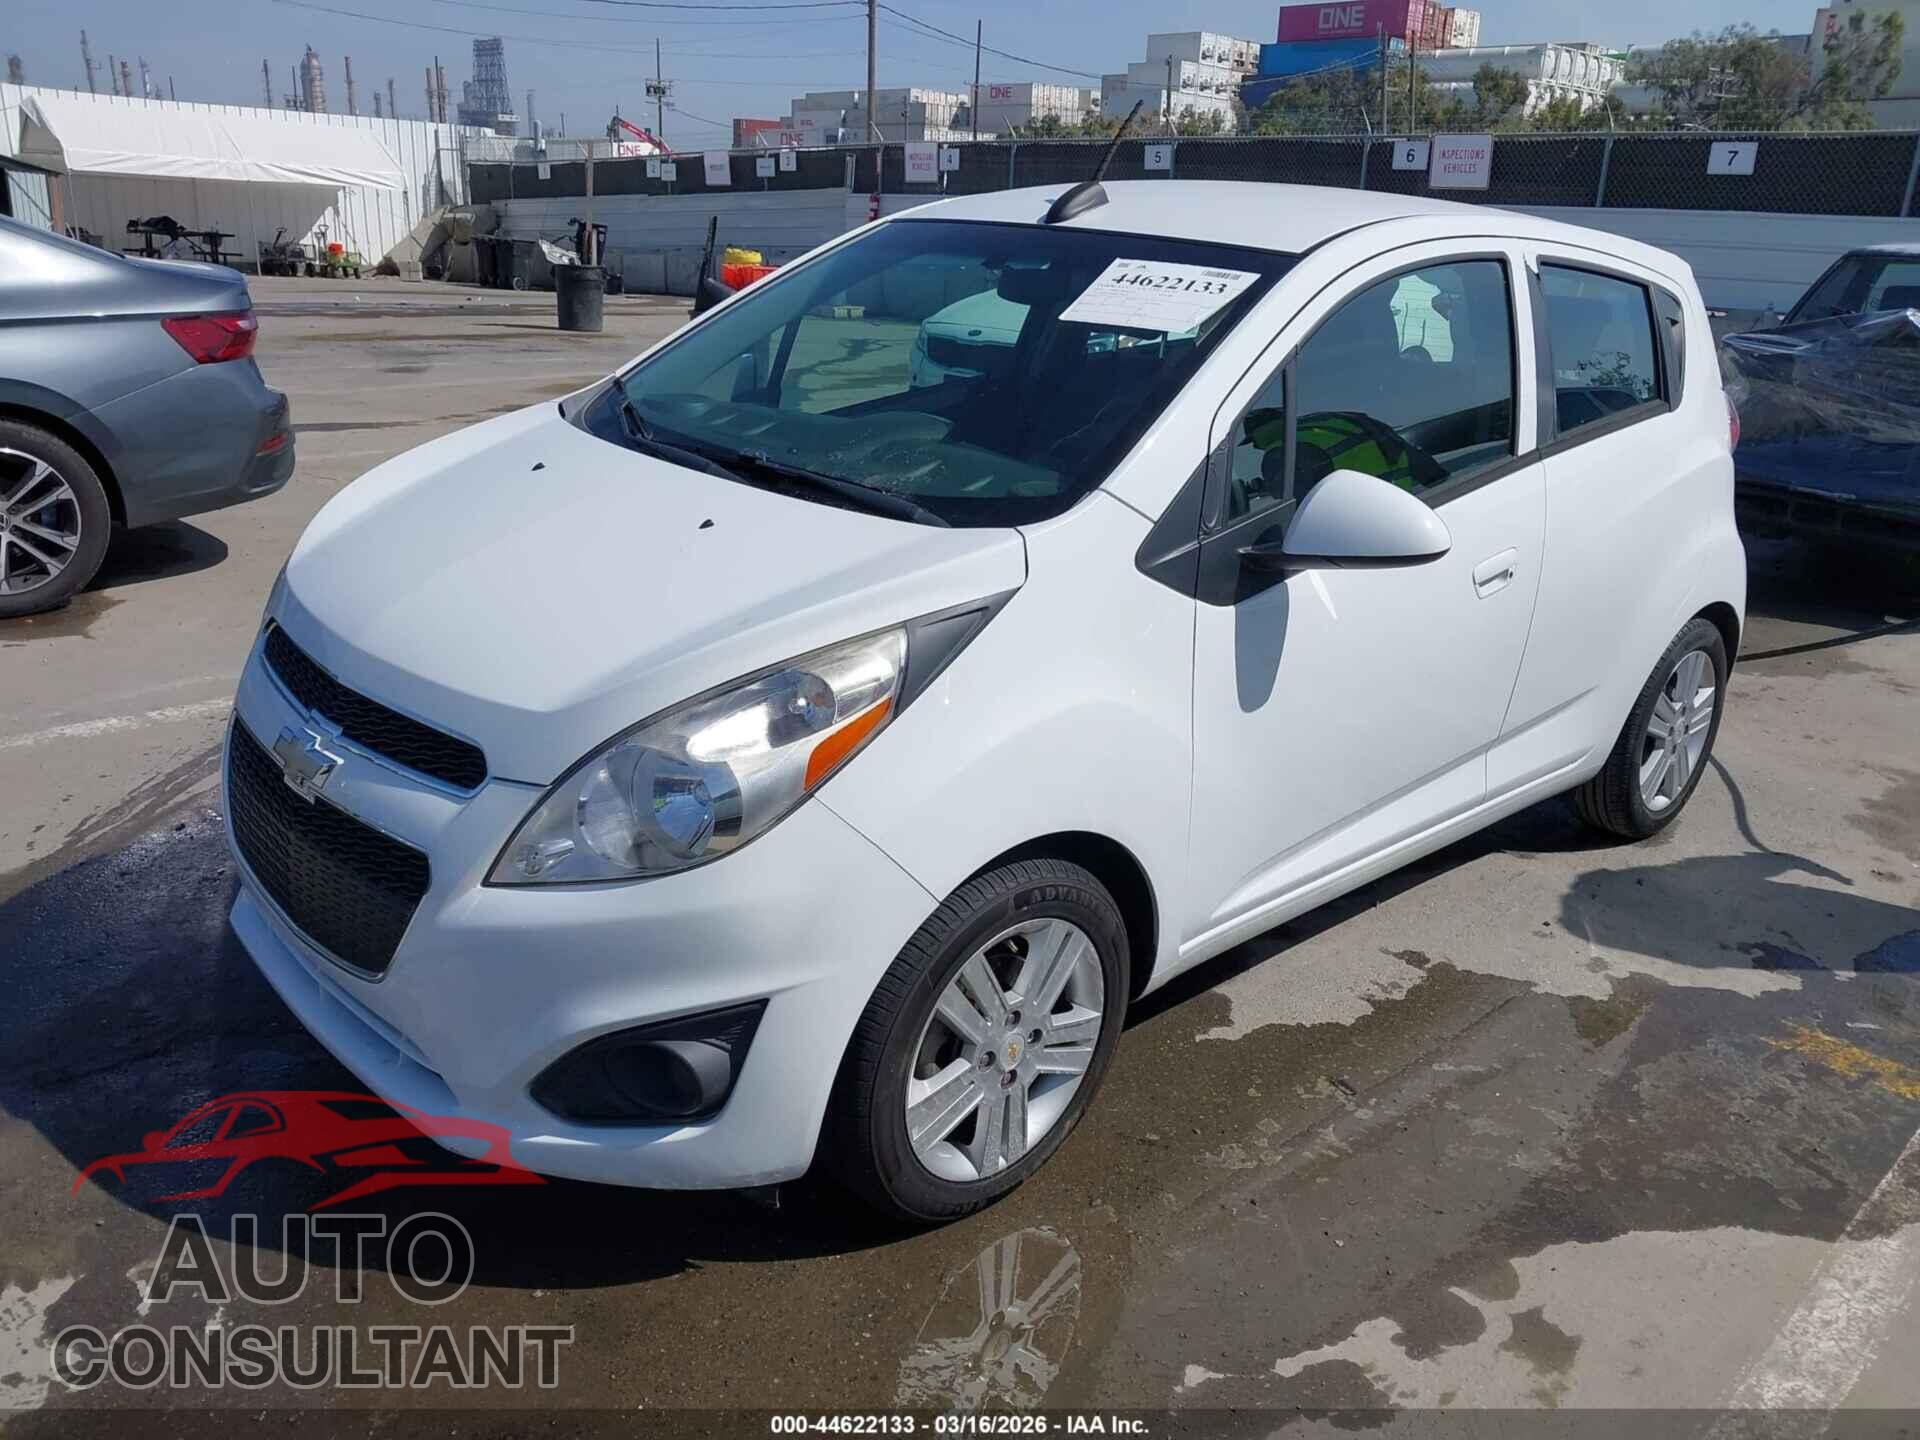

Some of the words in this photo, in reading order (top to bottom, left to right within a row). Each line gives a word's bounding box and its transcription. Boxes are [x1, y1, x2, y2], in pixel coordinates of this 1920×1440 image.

[1318, 5, 1365, 29] ONE
[1154, 151, 1162, 164] 5
[1406, 148, 1416, 163] 6
[1727, 150, 1739, 167] 7
[1112, 272, 1228, 295] 44622133
